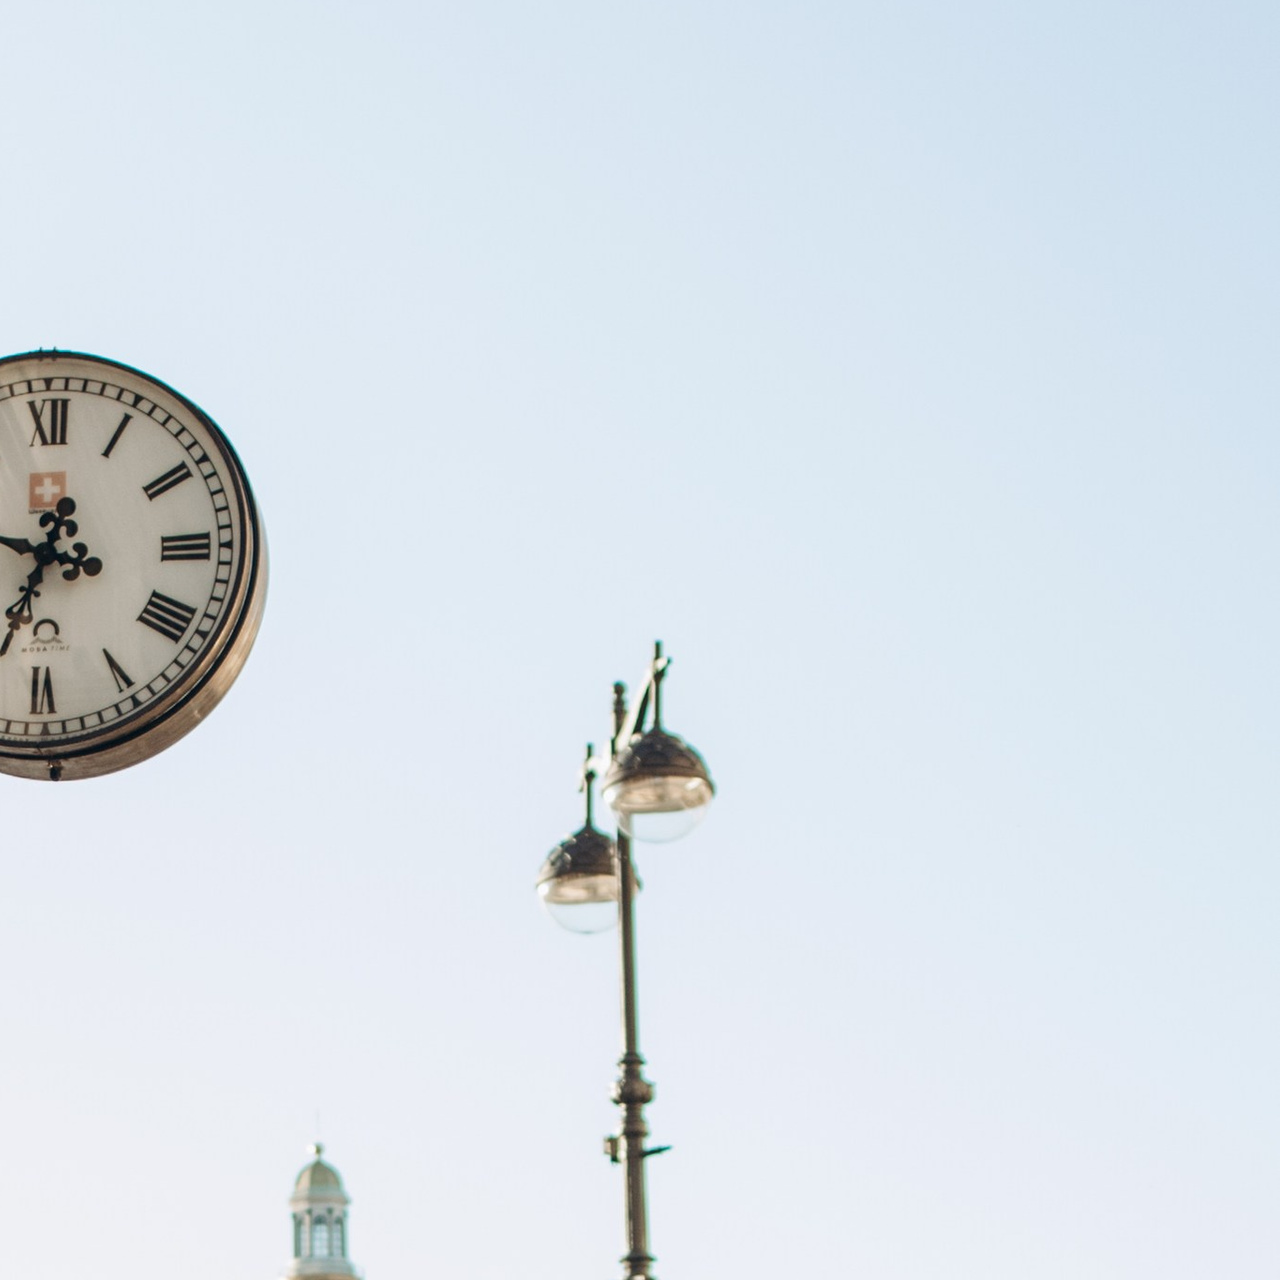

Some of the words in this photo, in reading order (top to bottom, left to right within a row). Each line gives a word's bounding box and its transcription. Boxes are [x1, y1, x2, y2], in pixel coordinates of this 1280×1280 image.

[27, 399, 70, 447] XII
[101, 413, 133, 458] I
[142, 461, 193, 501] II
[161, 531, 211, 561] III
[136, 589, 198, 644] IIII
[21, 645, 48, 653] MOBA
[102, 648, 136, 693] V
[30, 666, 57, 714] VI
